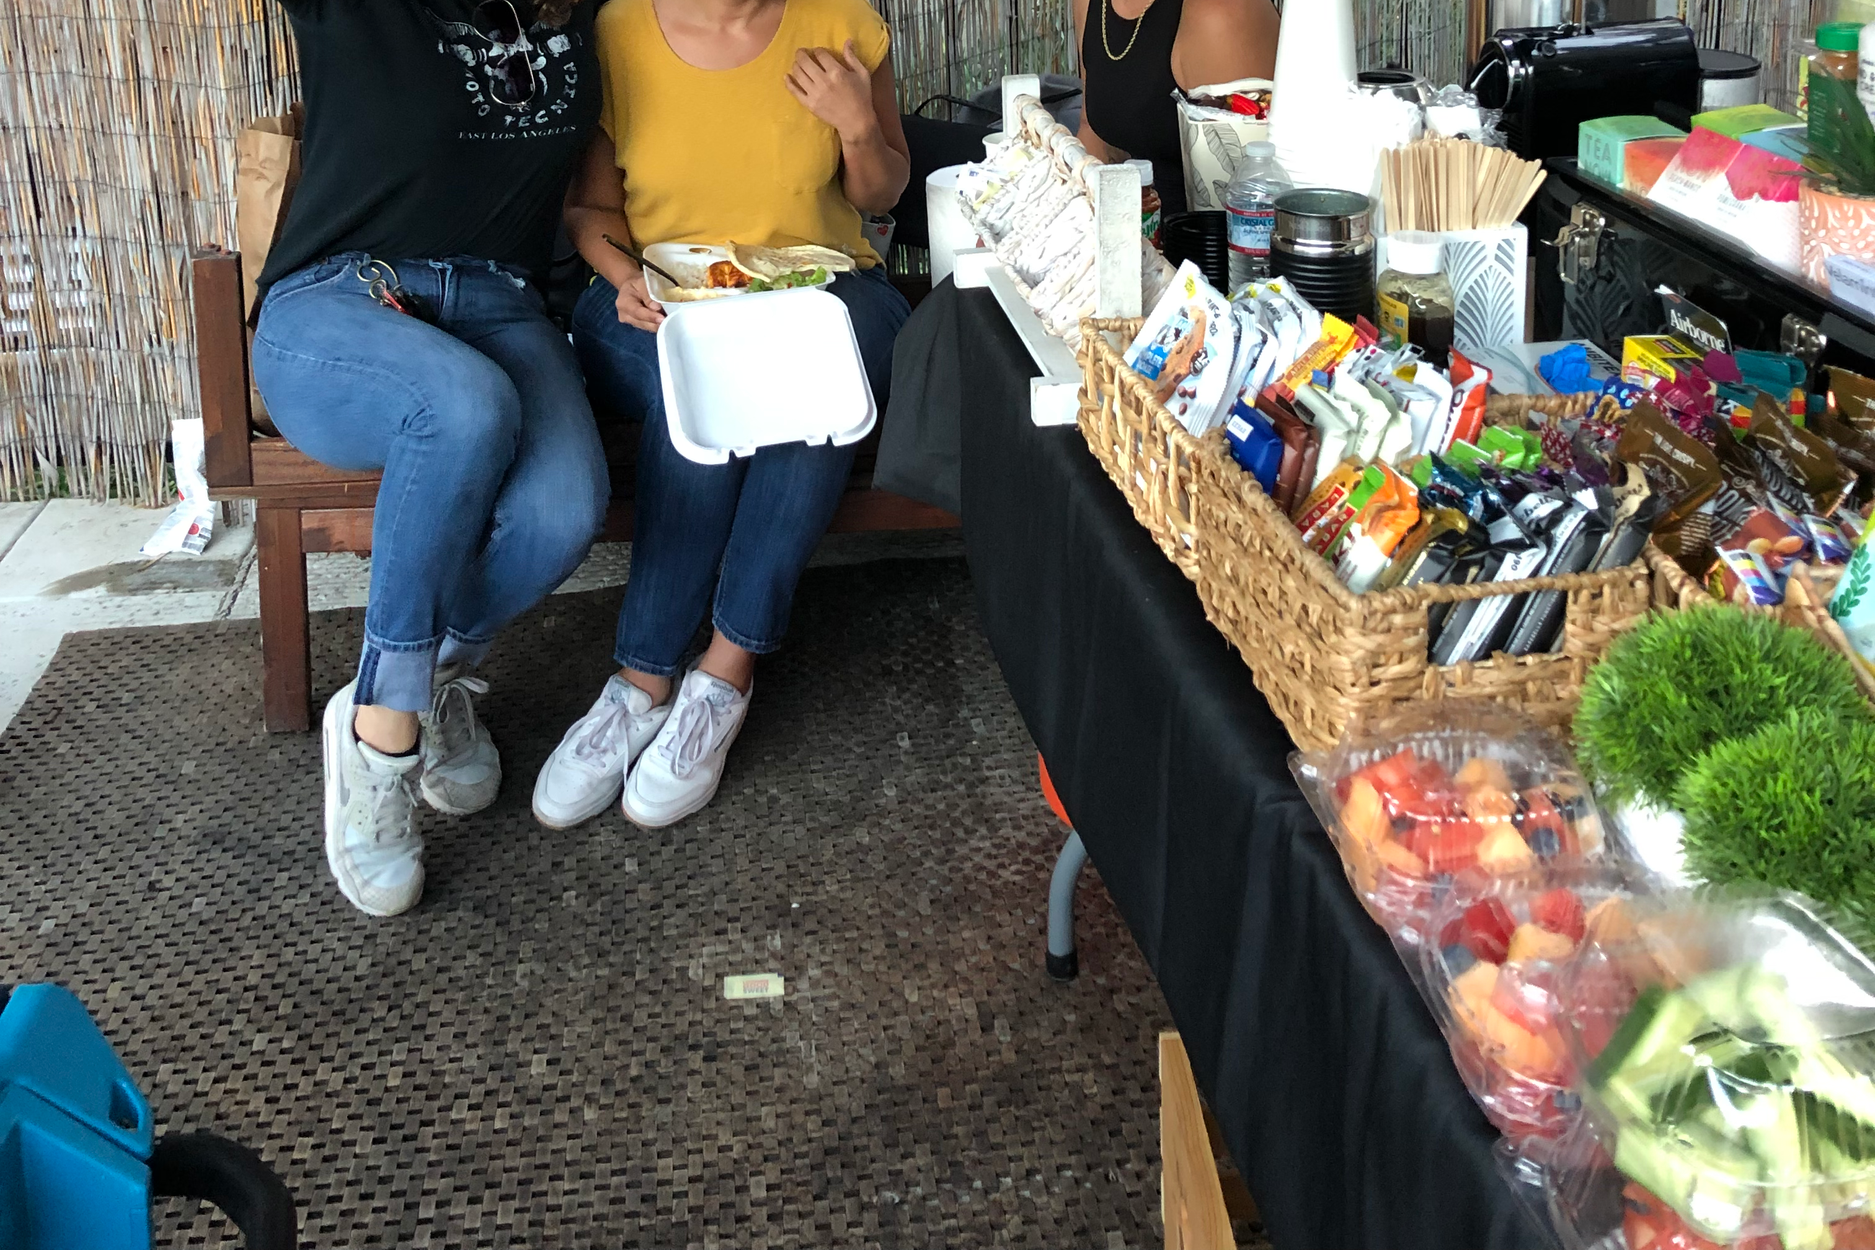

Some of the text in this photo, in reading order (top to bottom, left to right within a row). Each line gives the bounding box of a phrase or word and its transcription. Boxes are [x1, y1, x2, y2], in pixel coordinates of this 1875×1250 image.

[458, 124, 577, 140] EAST LOS ANGELES
[1584, 133, 1612, 165] TEA
[1240, 217, 1267, 227] CRYSTAL
[1670, 308, 1726, 354] Airborne
